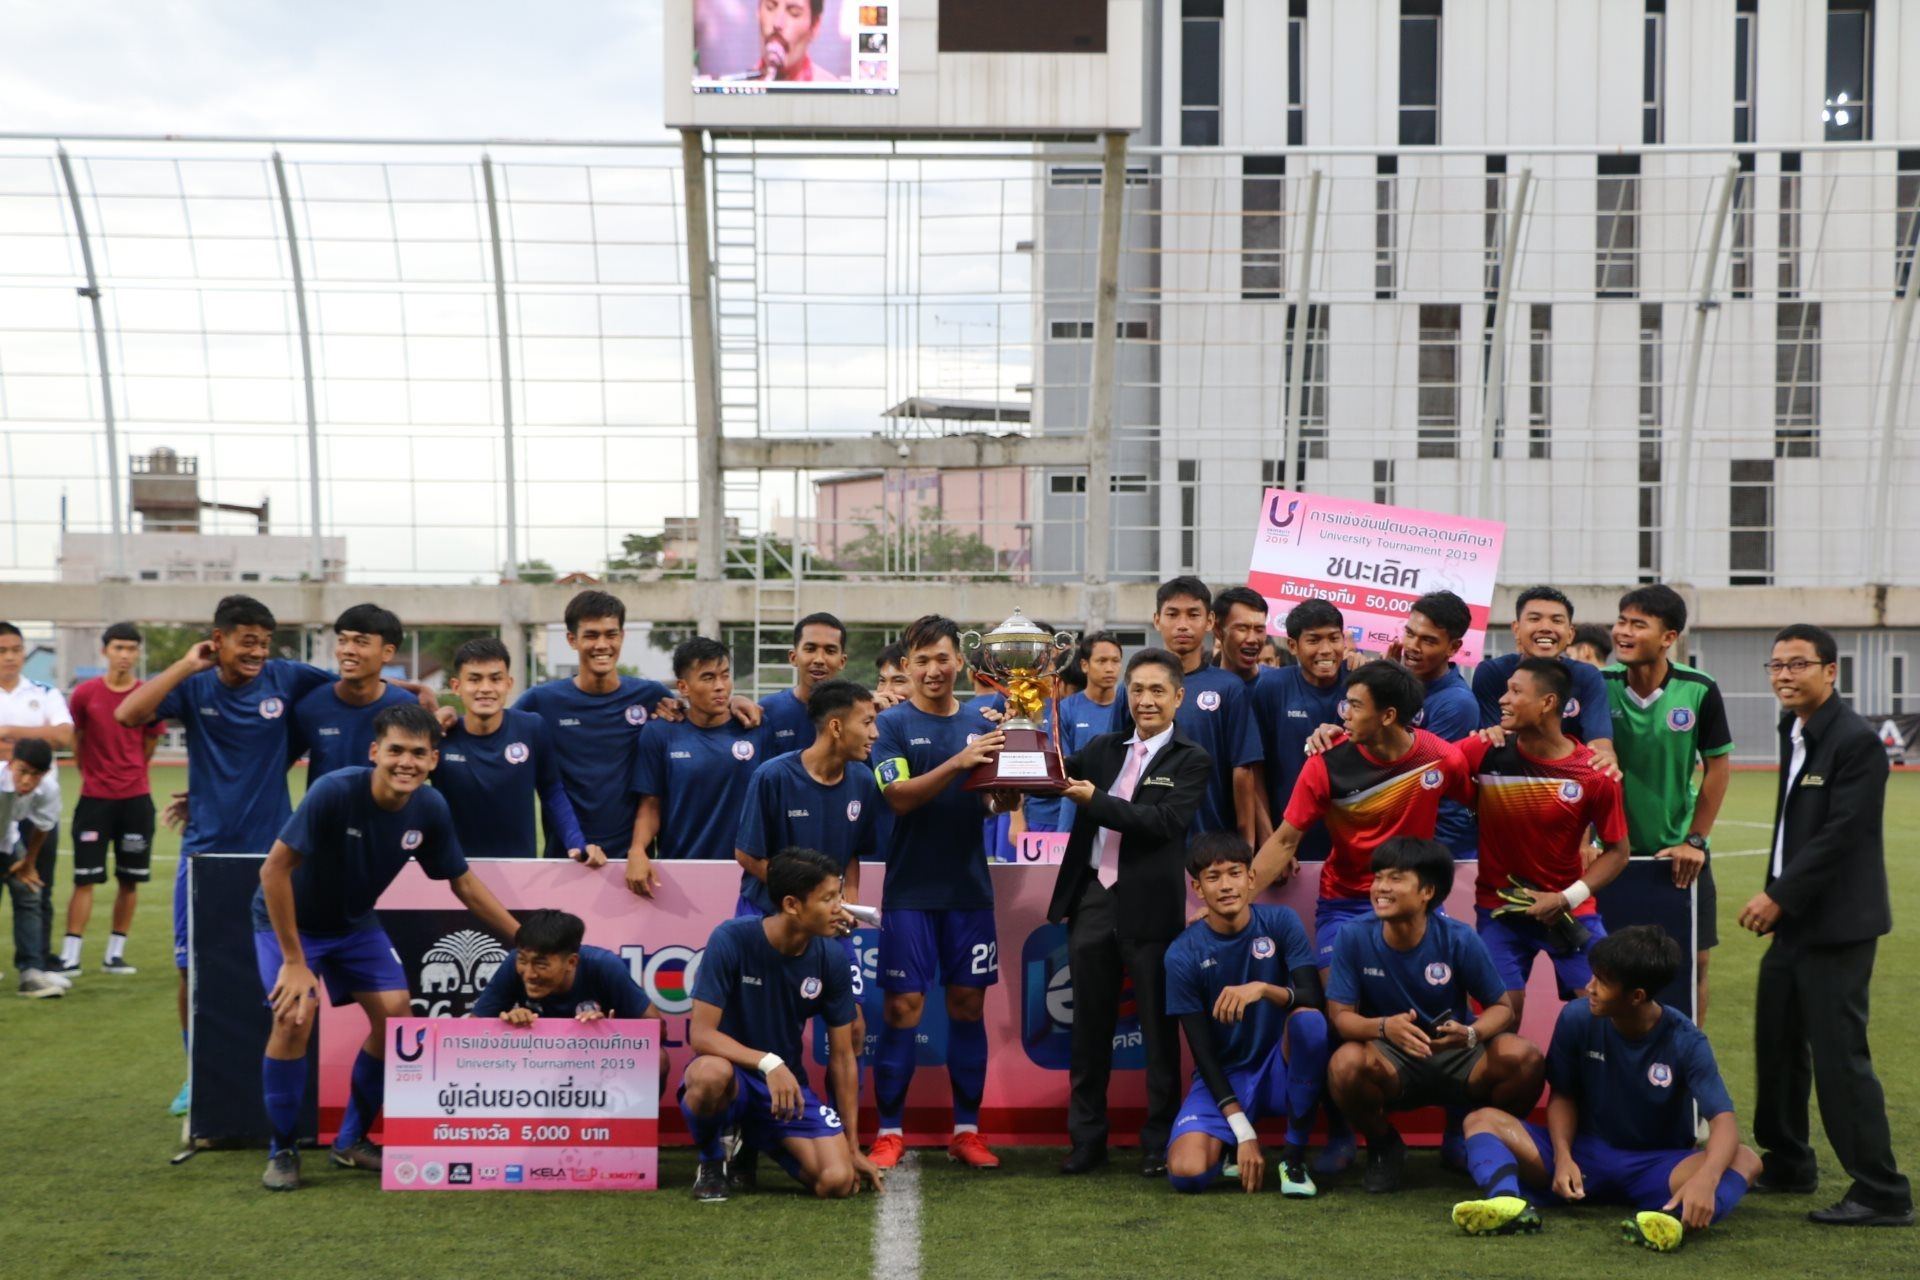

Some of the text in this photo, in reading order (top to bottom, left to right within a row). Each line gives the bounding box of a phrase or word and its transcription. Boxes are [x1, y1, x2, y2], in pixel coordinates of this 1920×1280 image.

[1265, 535, 1289, 544] 2019
[1310, 509, 1494, 548] การแข่งขันฟุตบอลอุดมศึกษา
[1319, 529, 1477, 562] University Tournament 2019
[1326, 556, 1420, 589] ชนะเลิศ
[1280, 581, 1356, 605] เงินบำรงทีม
[971, 940, 998, 975] 22
[442, 1031, 650, 1054] การแข่งขันฟุตบอลอุดมศึกษา
[456, 1057, 635, 1071] University Tournament 2019
[395, 1073, 423, 1082] 2019
[438, 1076, 606, 1116] ผู้เล่นยอดเยี่ยม
[433, 1124, 610, 1142] เงินรางวัล 5,000 บาท
[530, 1167, 566, 1177] KELA
